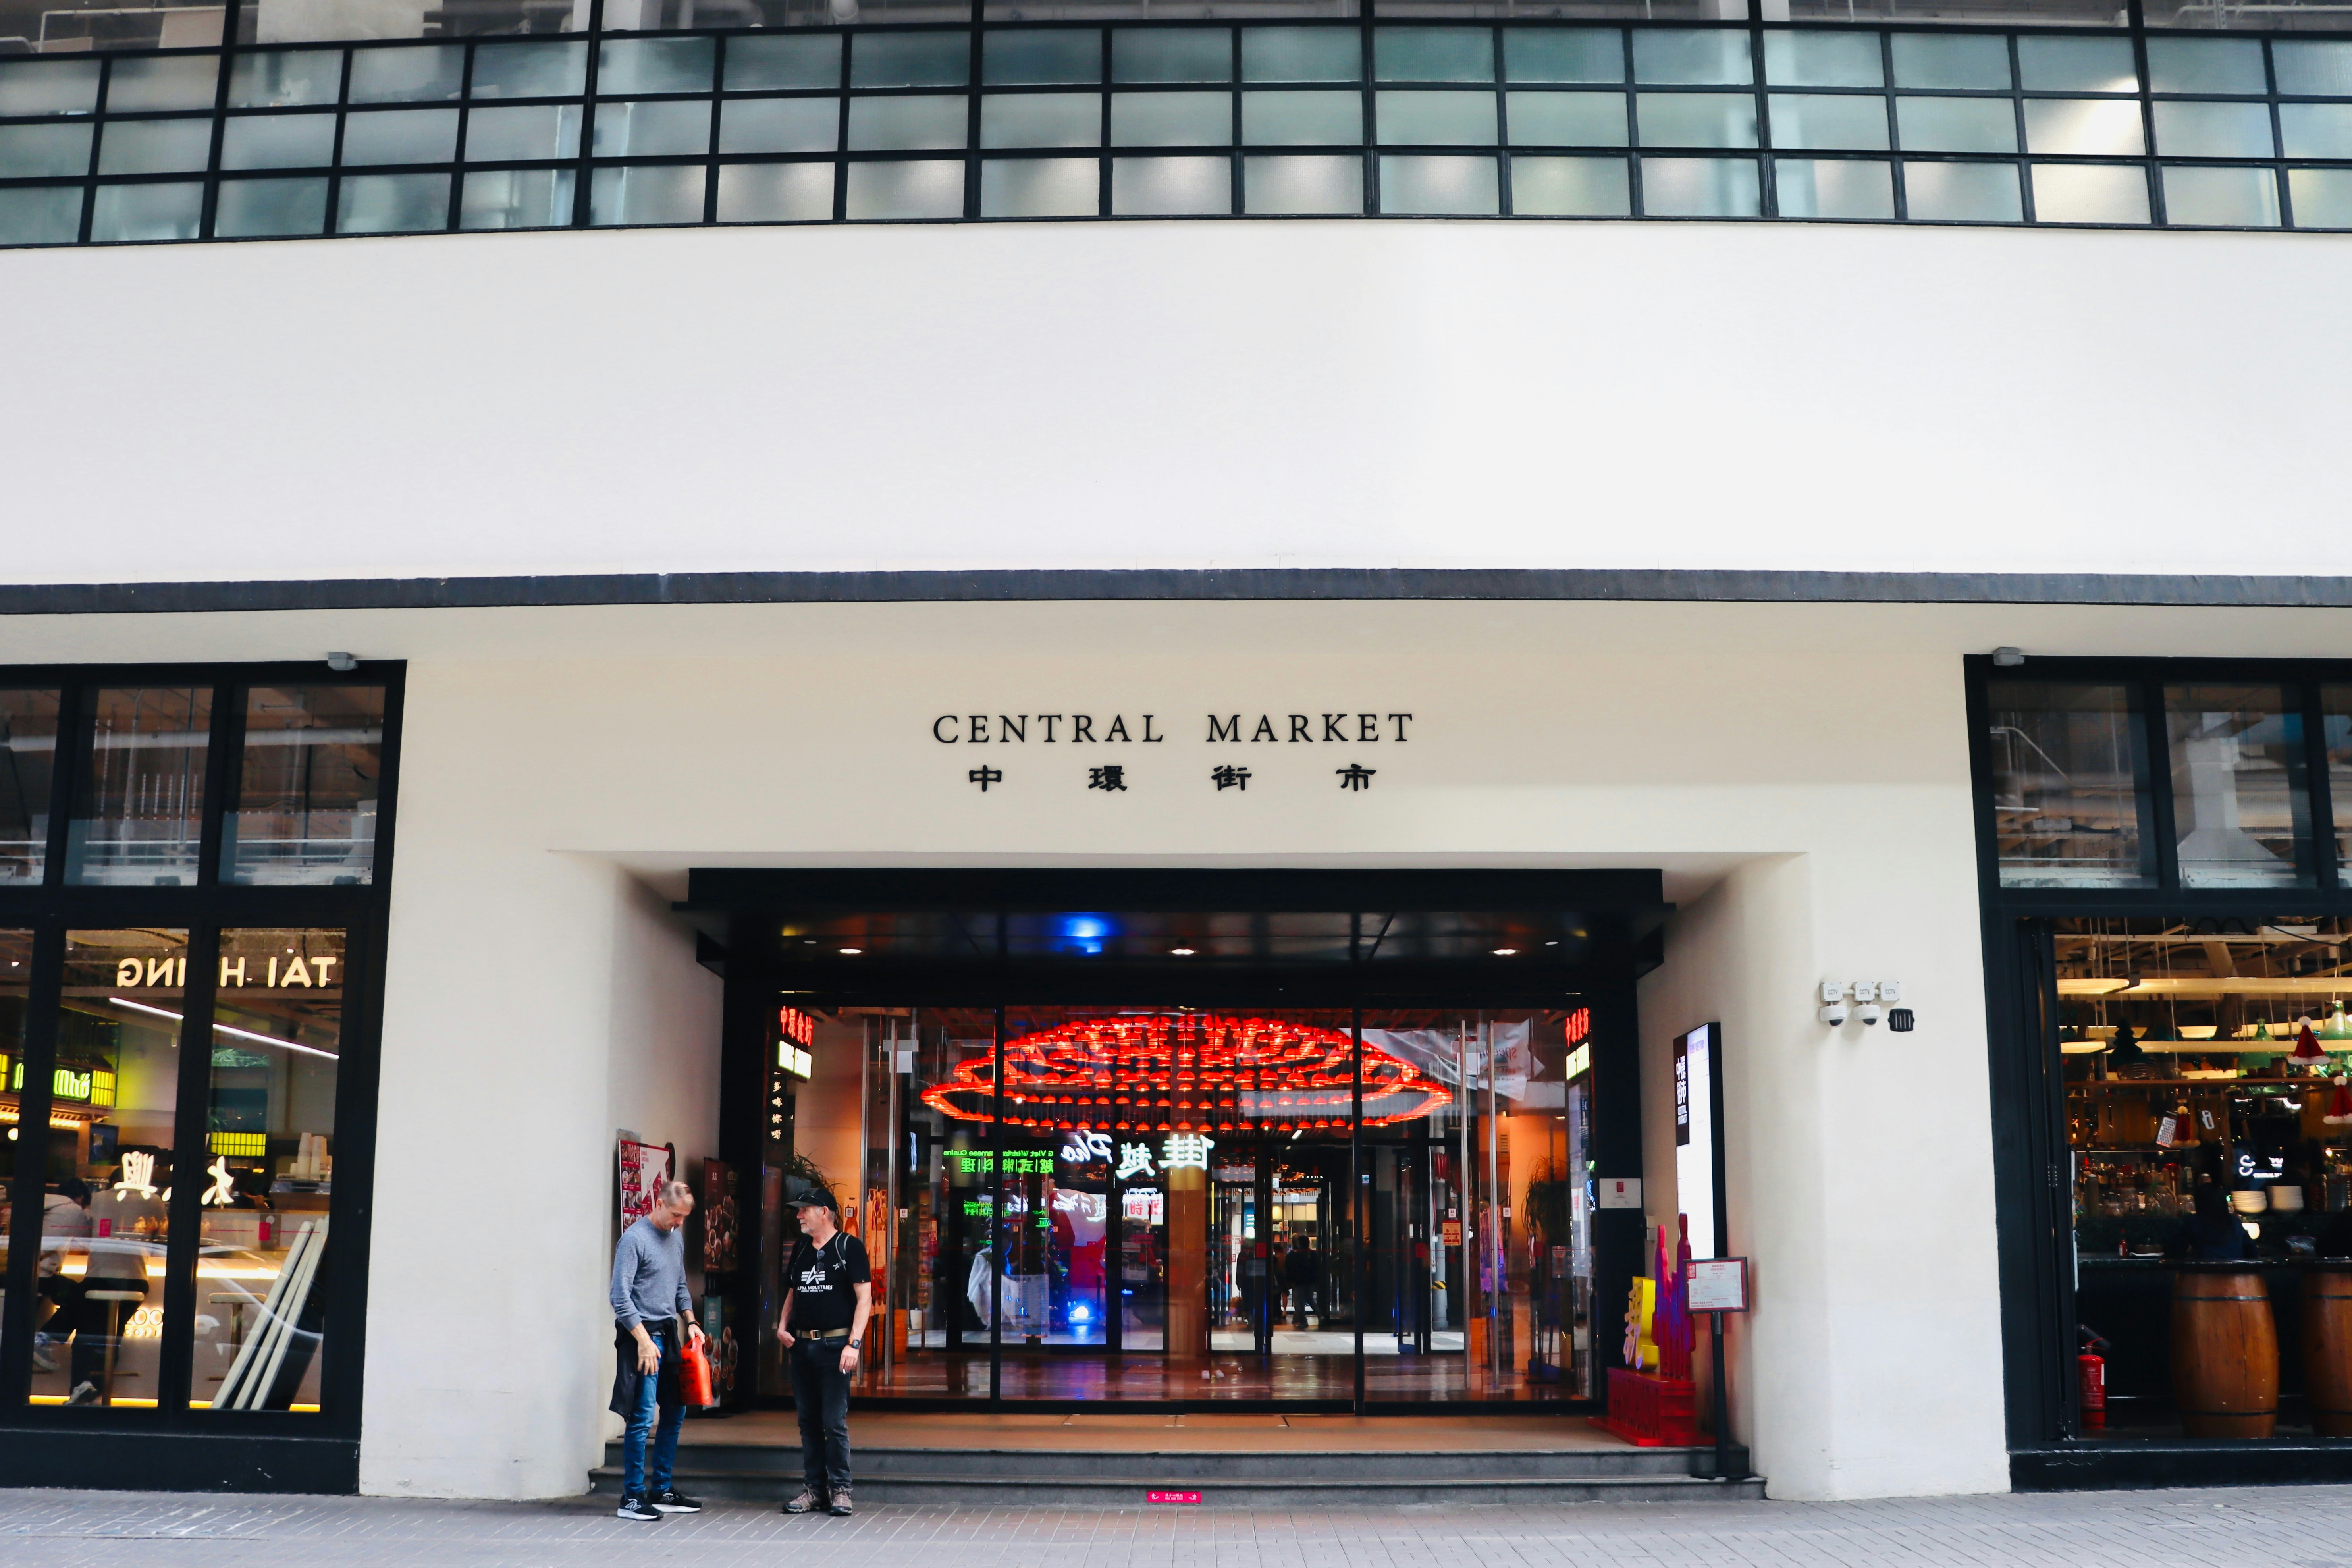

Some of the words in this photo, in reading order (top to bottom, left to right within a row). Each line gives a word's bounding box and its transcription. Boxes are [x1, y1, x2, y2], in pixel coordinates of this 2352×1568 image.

[933, 714, 1164, 743] CENTRAL
[1206, 713, 1413, 743] MARKET
[969, 764, 1377, 793] 中環街市
